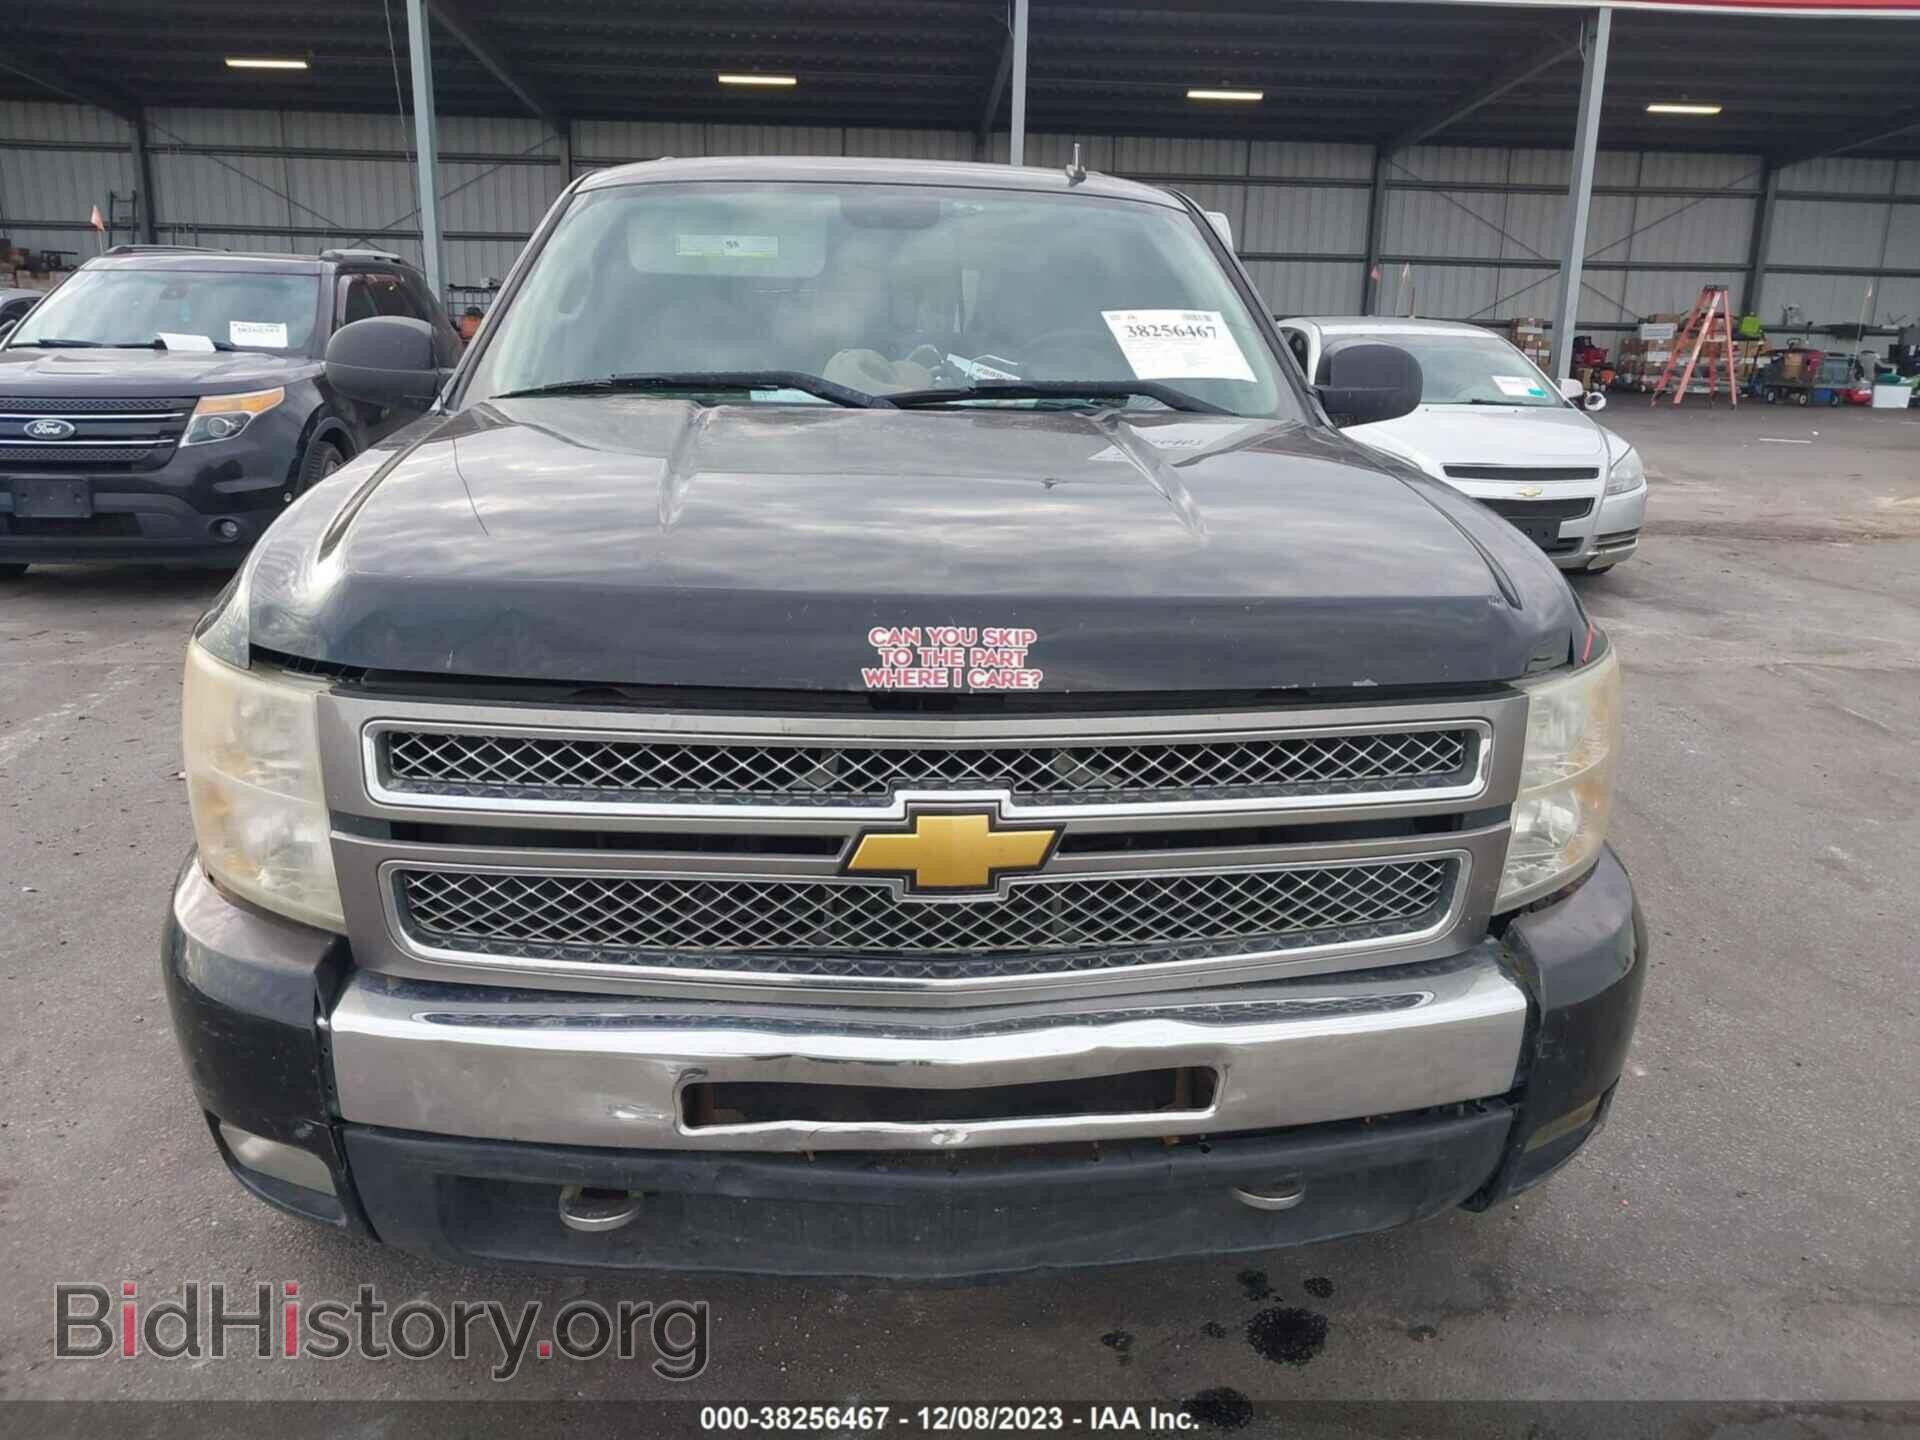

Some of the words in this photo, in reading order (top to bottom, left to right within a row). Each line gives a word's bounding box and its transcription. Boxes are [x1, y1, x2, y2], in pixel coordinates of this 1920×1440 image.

[1125, 324, 1217, 340] 38256467
[33, 422, 62, 434] Ford
[868, 627, 921, 647] CAN
[926, 627, 978, 647] YOU
[983, 628, 1037, 648] SKIP
[879, 648, 912, 668] TO
[918, 648, 965, 668] THE
[970, 648, 1028, 668] PART
[862, 668, 949, 688] WHERE
[953, 668, 963, 688] I
[967, 669, 1043, 689] CARE?
